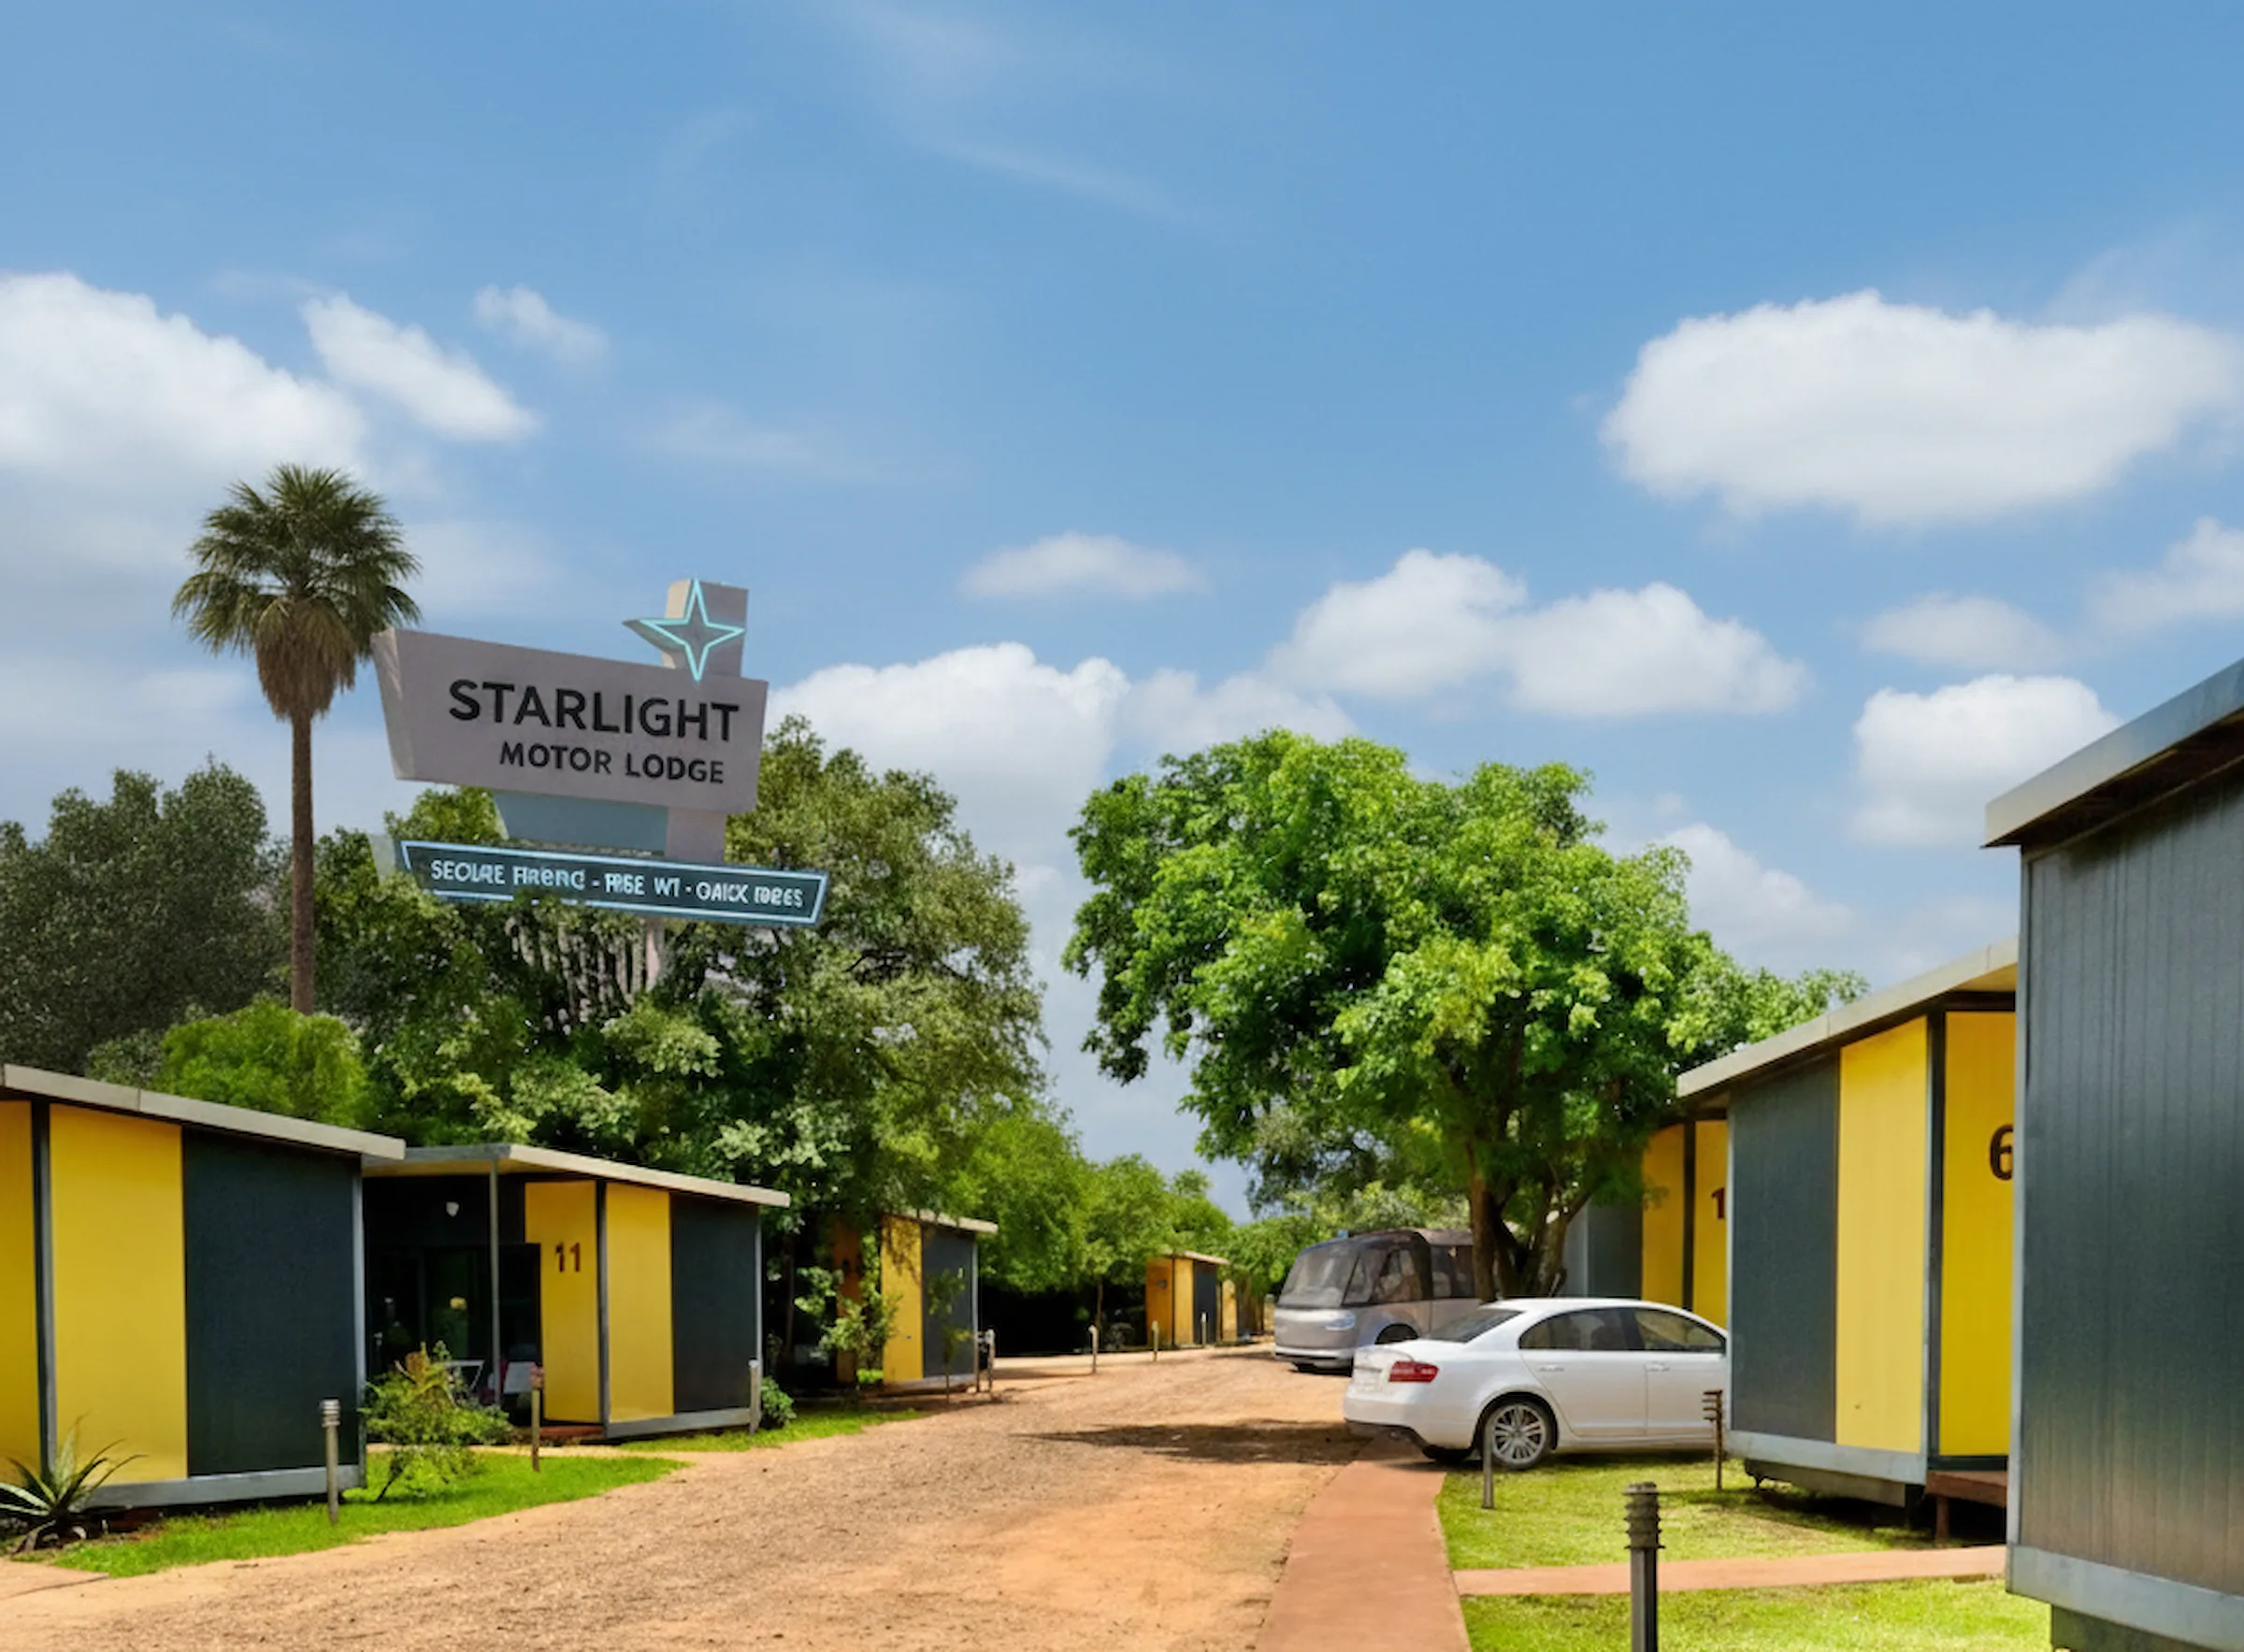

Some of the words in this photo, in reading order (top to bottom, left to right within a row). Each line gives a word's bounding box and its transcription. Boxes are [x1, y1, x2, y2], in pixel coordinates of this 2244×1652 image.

[449, 679, 740, 742] STARLIGHT
[499, 741, 612, 775] MOTOR
[625, 753, 725, 784] LODGE
[555, 1241, 581, 1273] 11
